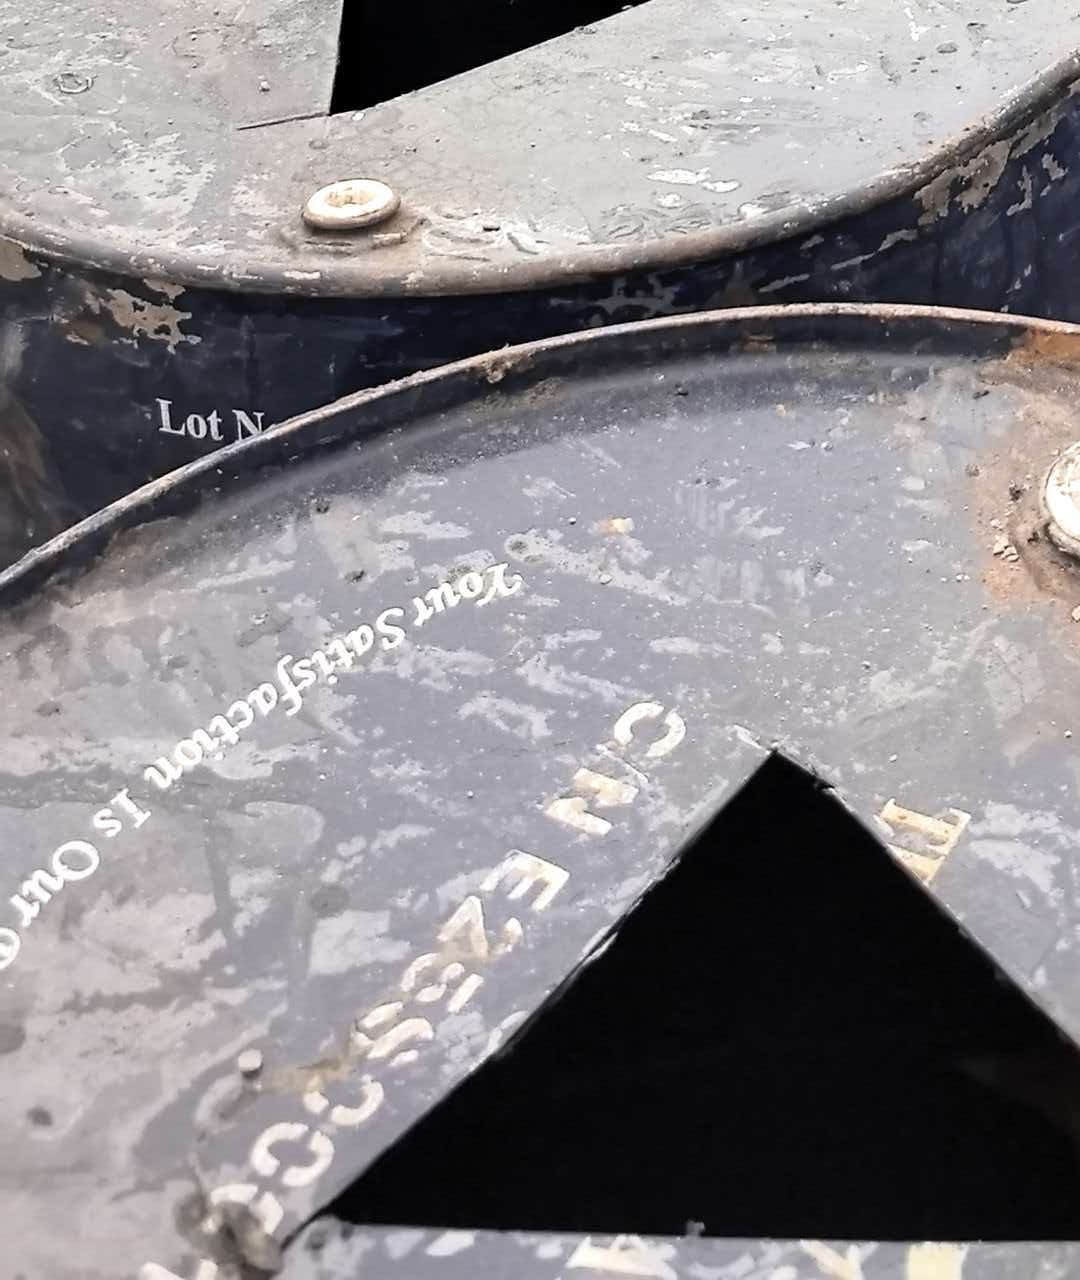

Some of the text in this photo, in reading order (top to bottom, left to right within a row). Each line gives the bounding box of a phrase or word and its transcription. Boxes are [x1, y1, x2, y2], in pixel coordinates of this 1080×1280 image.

[155, 397, 224, 441] Lot
[9, 561, 523, 928] Your Satisfaction Is Our
